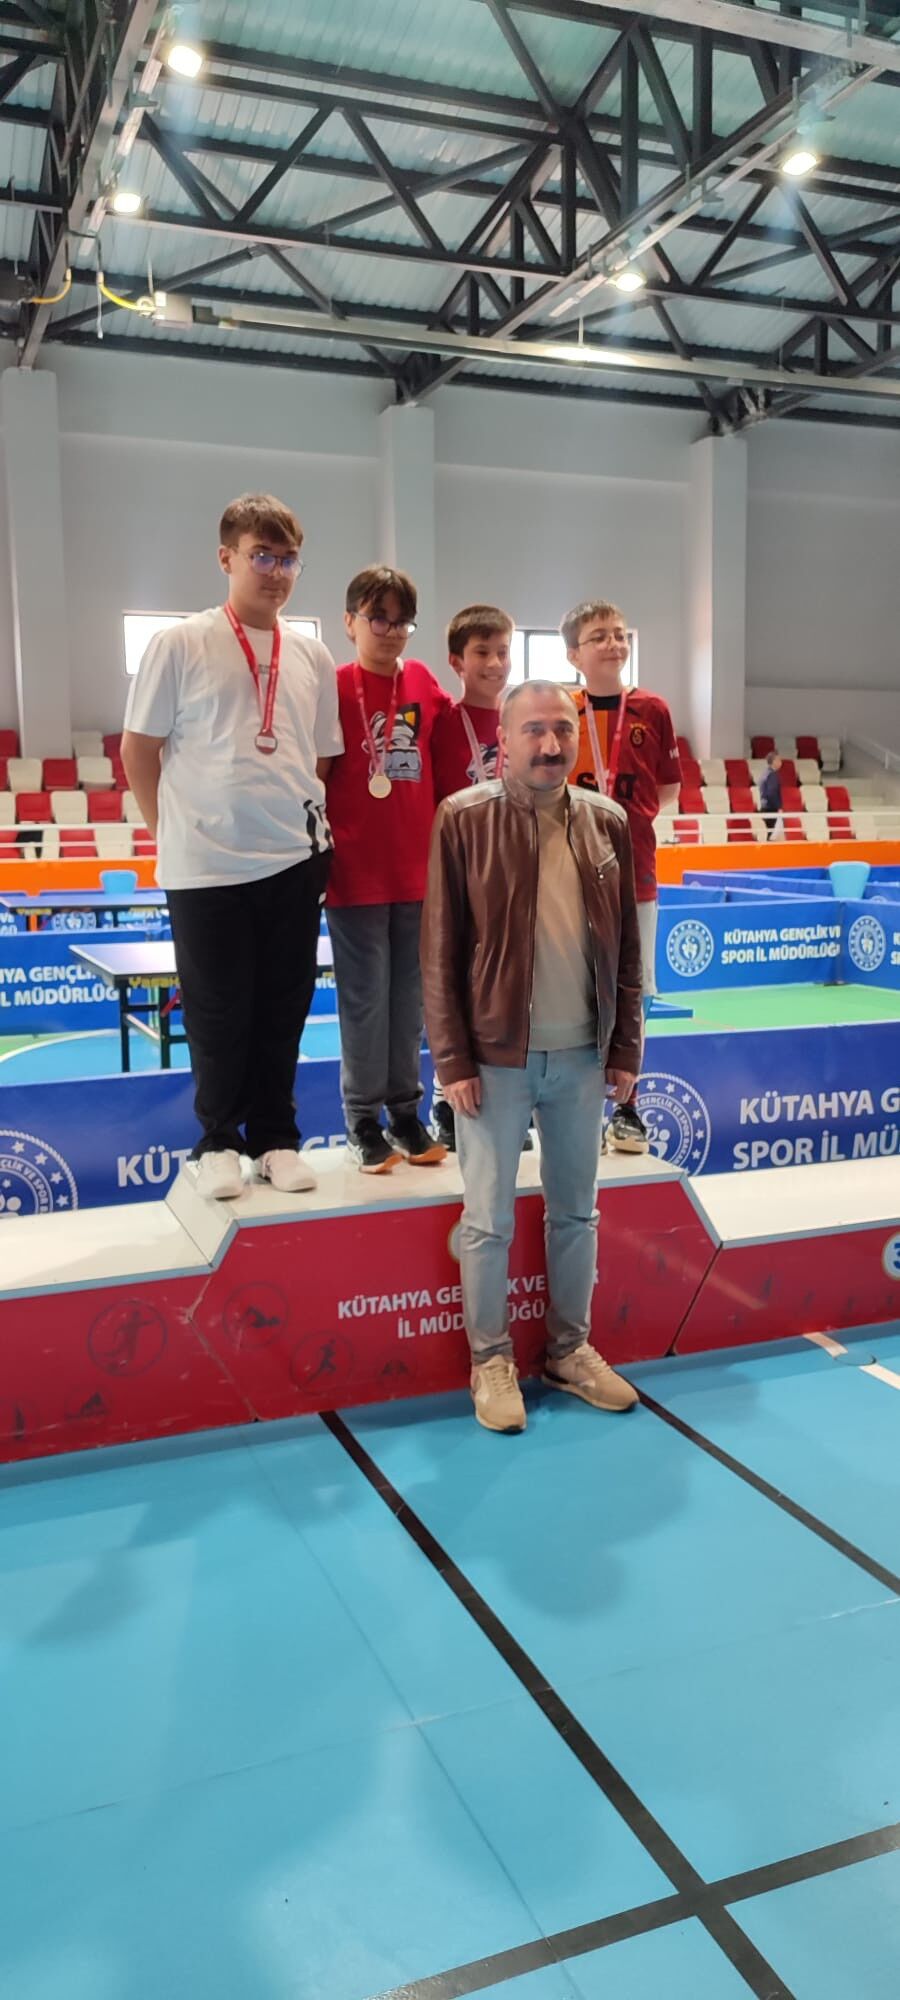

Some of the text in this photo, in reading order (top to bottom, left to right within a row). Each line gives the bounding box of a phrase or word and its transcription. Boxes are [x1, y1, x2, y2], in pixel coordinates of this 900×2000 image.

[724, 929, 776, 944] KÜTAHYA
[780, 924, 828, 943] GENÇLİK
[721, 951, 755, 965] SPOR
[756, 946, 767, 962] İL
[740, 1090, 875, 1125] KÜTAHYA
[733, 1123, 900, 1170] SPOR İL MÜ
[338, 1290, 432, 1320] KÜTAHYA
[522, 1274, 546, 1293] VE
[398, 1317, 416, 1339] İL
